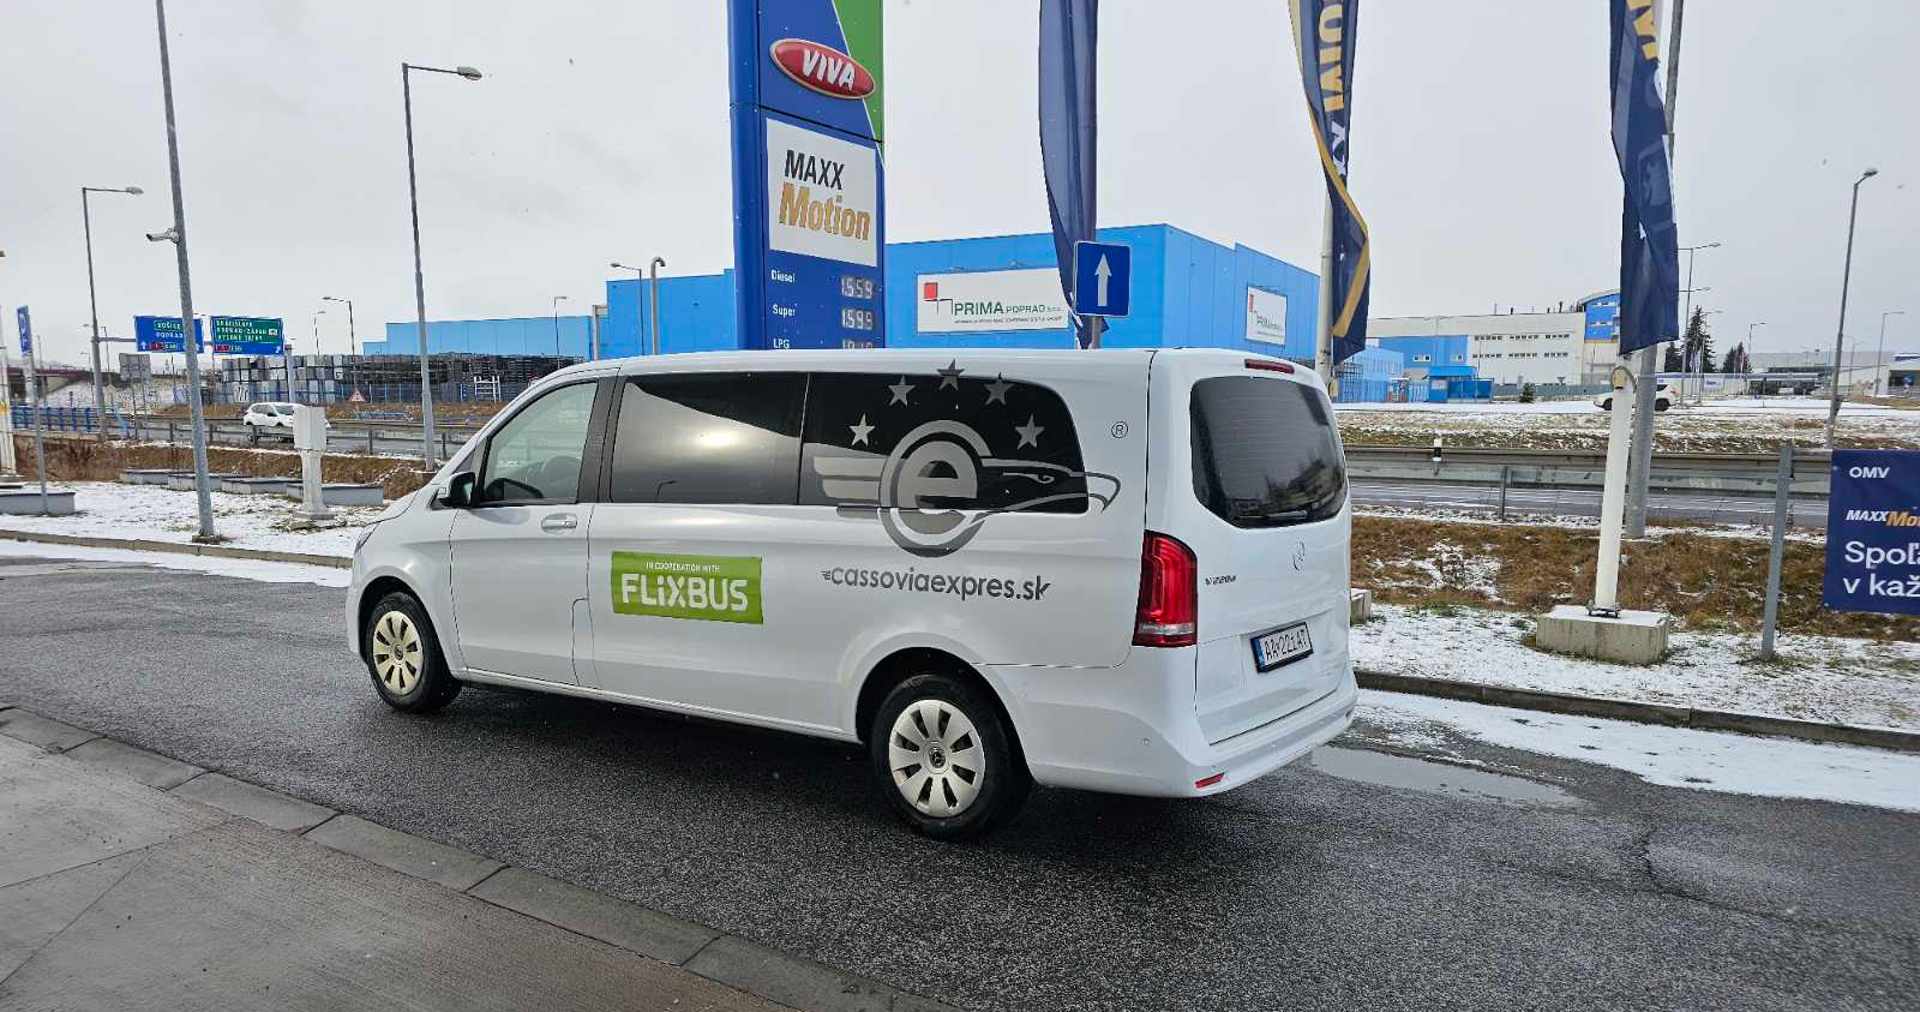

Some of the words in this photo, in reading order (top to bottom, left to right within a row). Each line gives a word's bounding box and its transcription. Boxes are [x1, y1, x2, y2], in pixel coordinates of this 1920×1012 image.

[802, 49, 855, 91] VIVA
[784, 149, 844, 190] MAXX
[779, 181, 871, 241] Motion
[771, 269, 795, 284] Diesel
[772, 303, 796, 318] Super
[954, 301, 1004, 316] PRIMA
[1005, 304, 1046, 314] POPRAD
[773, 337, 790, 349] LPG
[1849, 466, 1890, 479] OMV
[1844, 540, 1920, 569] Spoľ
[830, 566, 1051, 600] cassoviaexpres.sk
[1842, 577, 1861, 594] v
